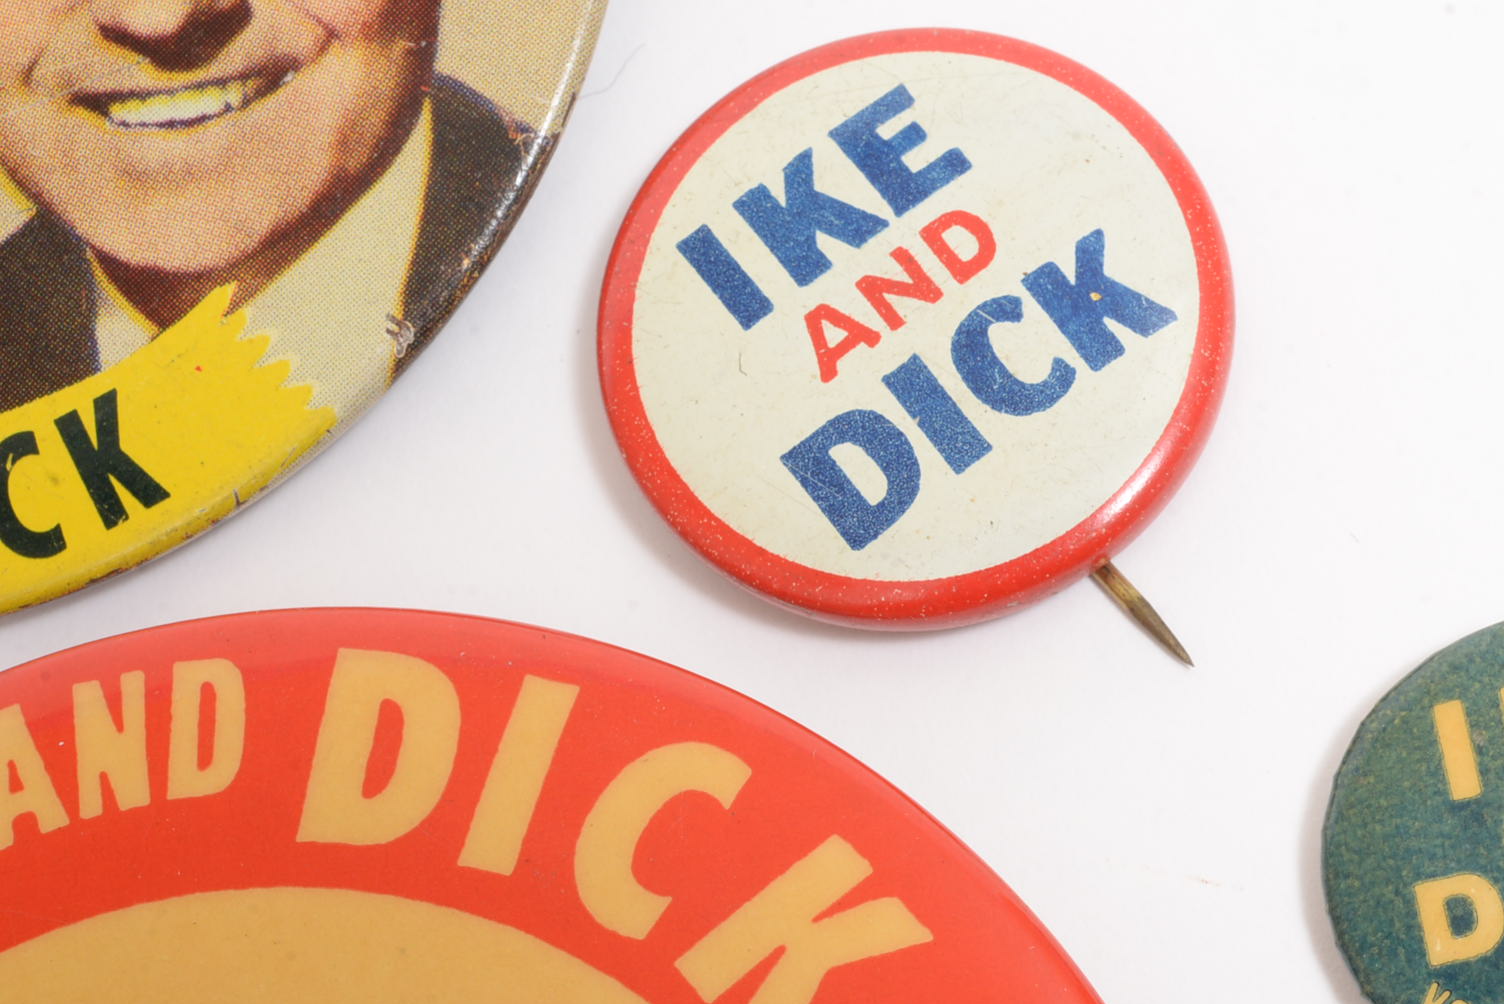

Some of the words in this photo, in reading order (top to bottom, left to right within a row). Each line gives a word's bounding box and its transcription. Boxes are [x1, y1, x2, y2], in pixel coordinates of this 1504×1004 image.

[676, 83, 973, 331] IKE
[804, 209, 997, 383] AND
[0, 388, 171, 560] CK
[780, 229, 1179, 551] DICK
[0, 658, 246, 850] AND
